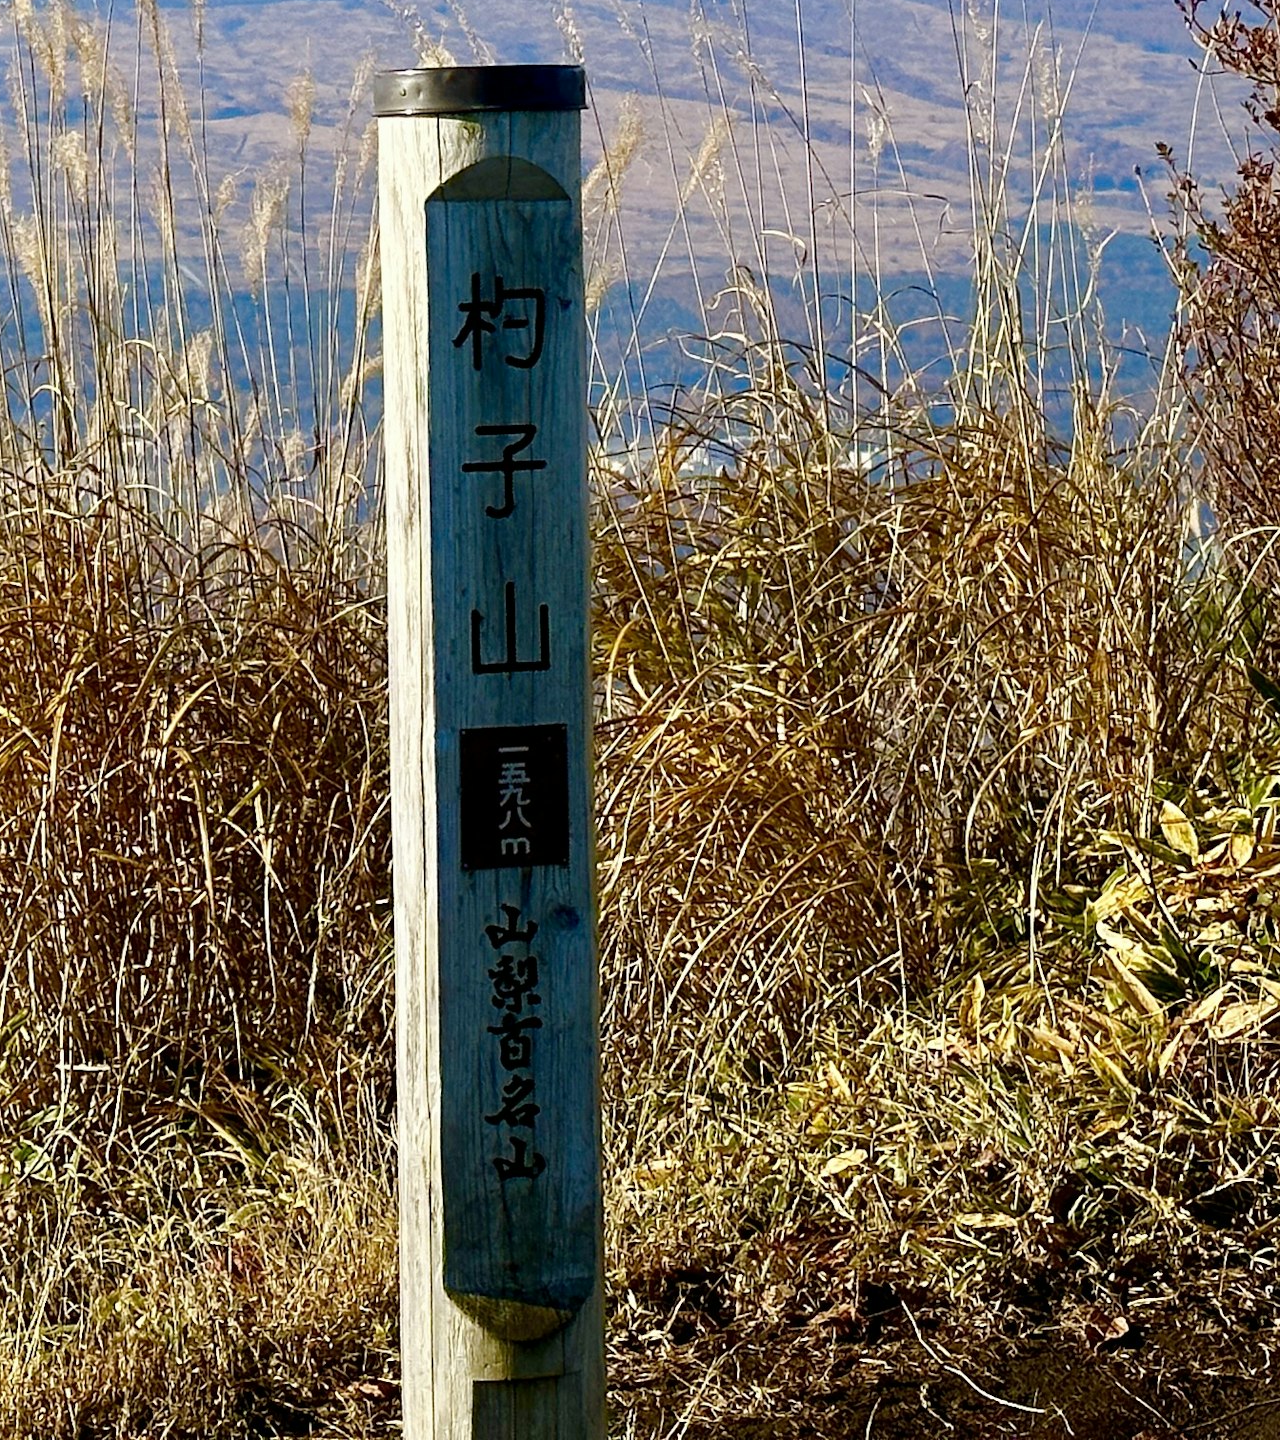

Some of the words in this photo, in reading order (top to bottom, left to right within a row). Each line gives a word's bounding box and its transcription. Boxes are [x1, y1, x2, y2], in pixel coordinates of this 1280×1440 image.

[452, 272, 550, 674] 杓子山
[484, 903, 546, 1180] 山梨百名山
